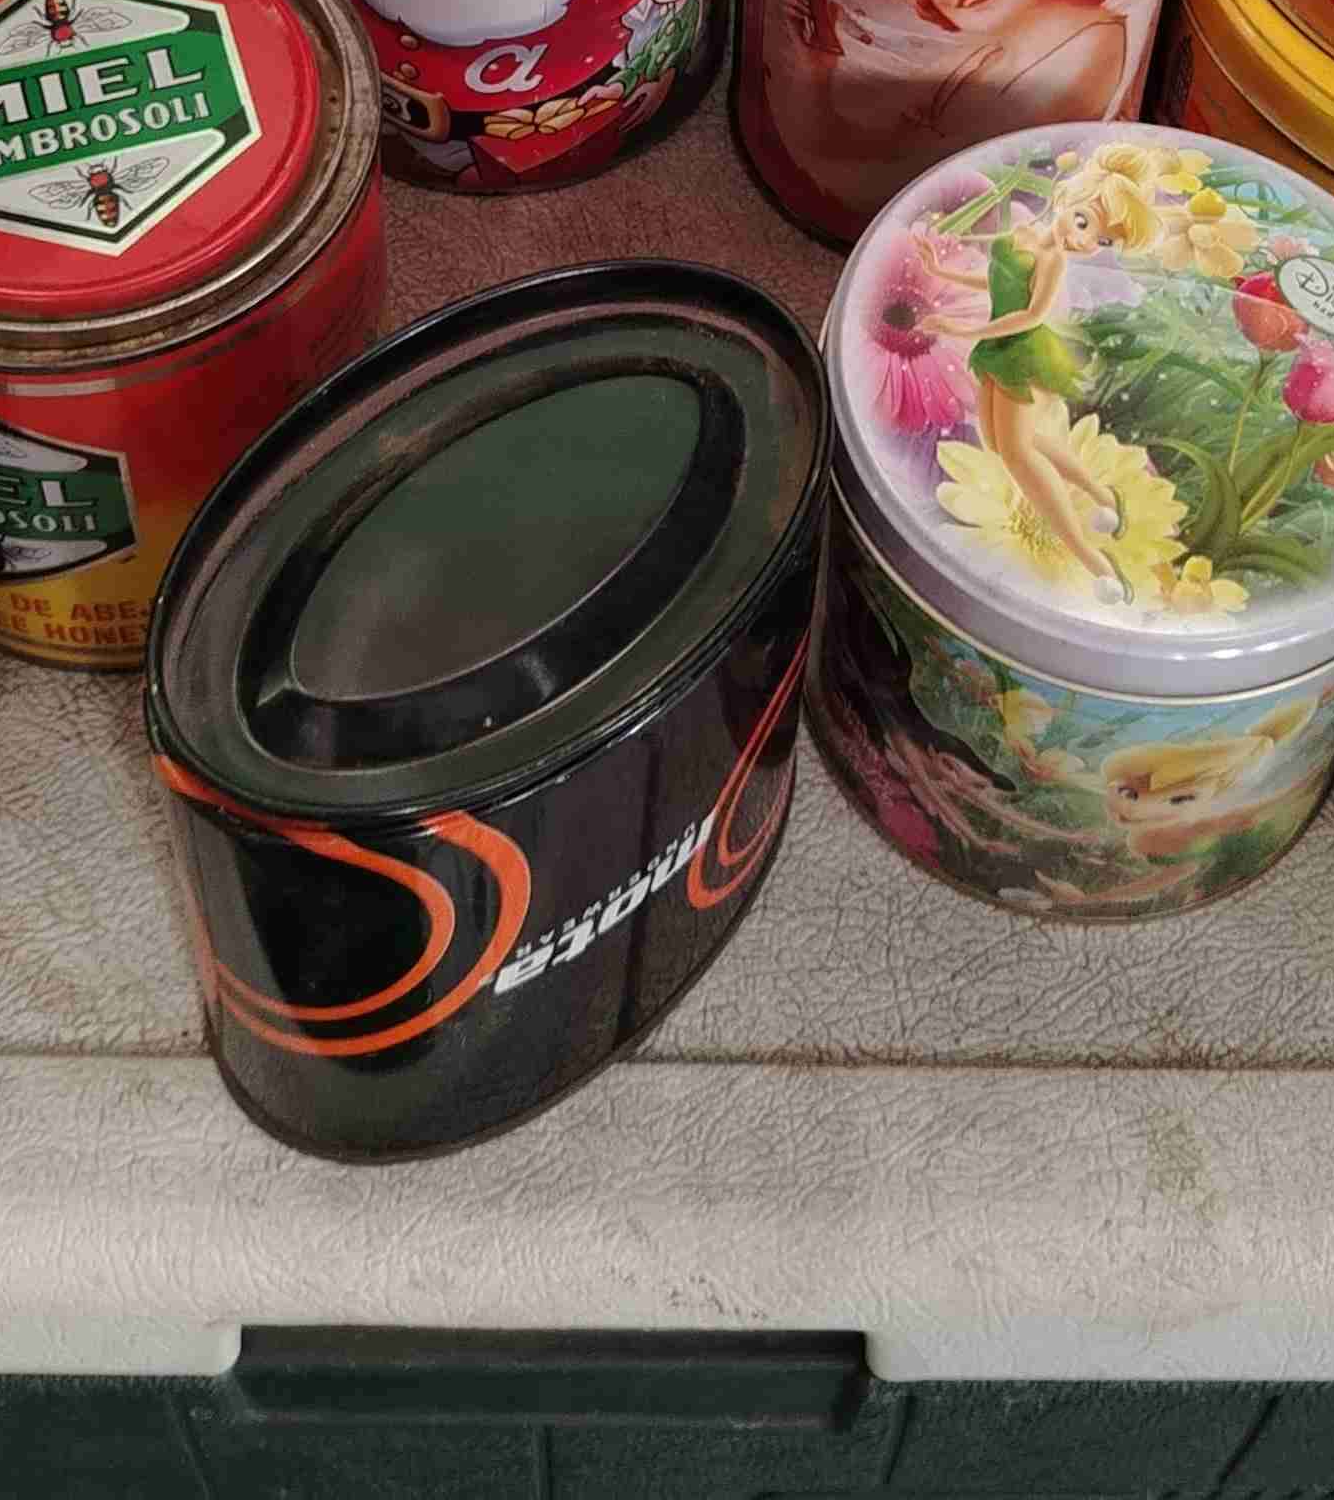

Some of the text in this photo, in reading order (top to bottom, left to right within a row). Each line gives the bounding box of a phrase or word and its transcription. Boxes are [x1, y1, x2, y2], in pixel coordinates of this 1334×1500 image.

[44, 622, 147, 646] HONE
[493, 802, 720, 996] mota
[516, 820, 697, 959] UNDERWEAR
